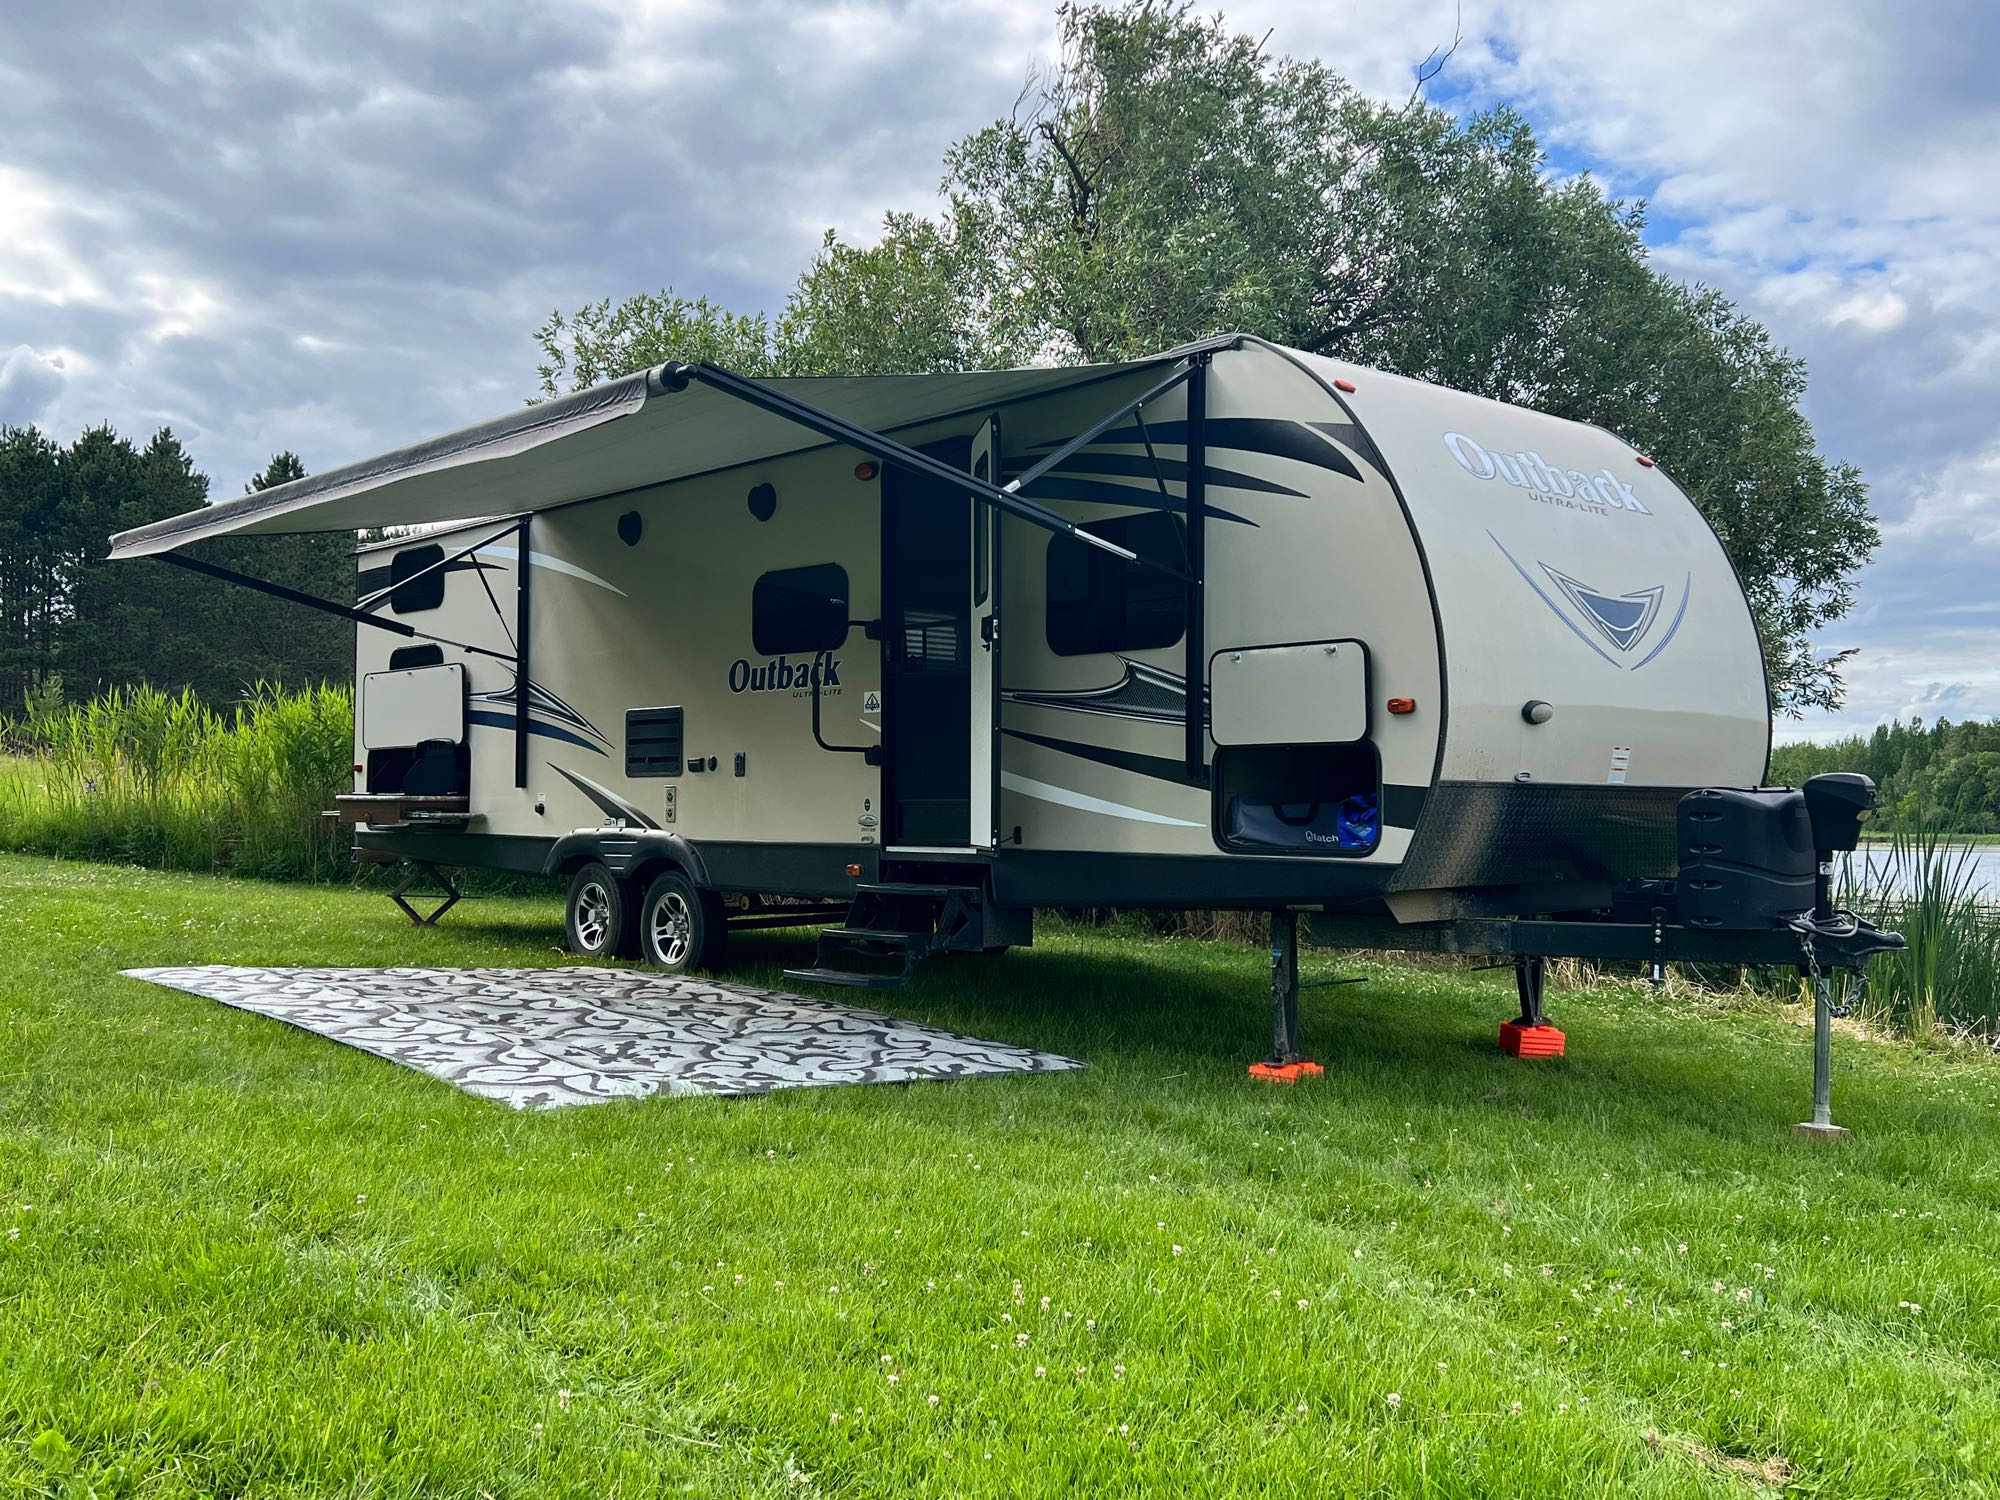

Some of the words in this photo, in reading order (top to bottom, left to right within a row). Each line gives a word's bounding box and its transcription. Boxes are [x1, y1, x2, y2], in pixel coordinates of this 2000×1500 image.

[1443, 431, 1653, 516] Outback
[1528, 492, 1609, 516] ULTRA-LITE
[792, 688, 843, 698] ULTR-LITE
